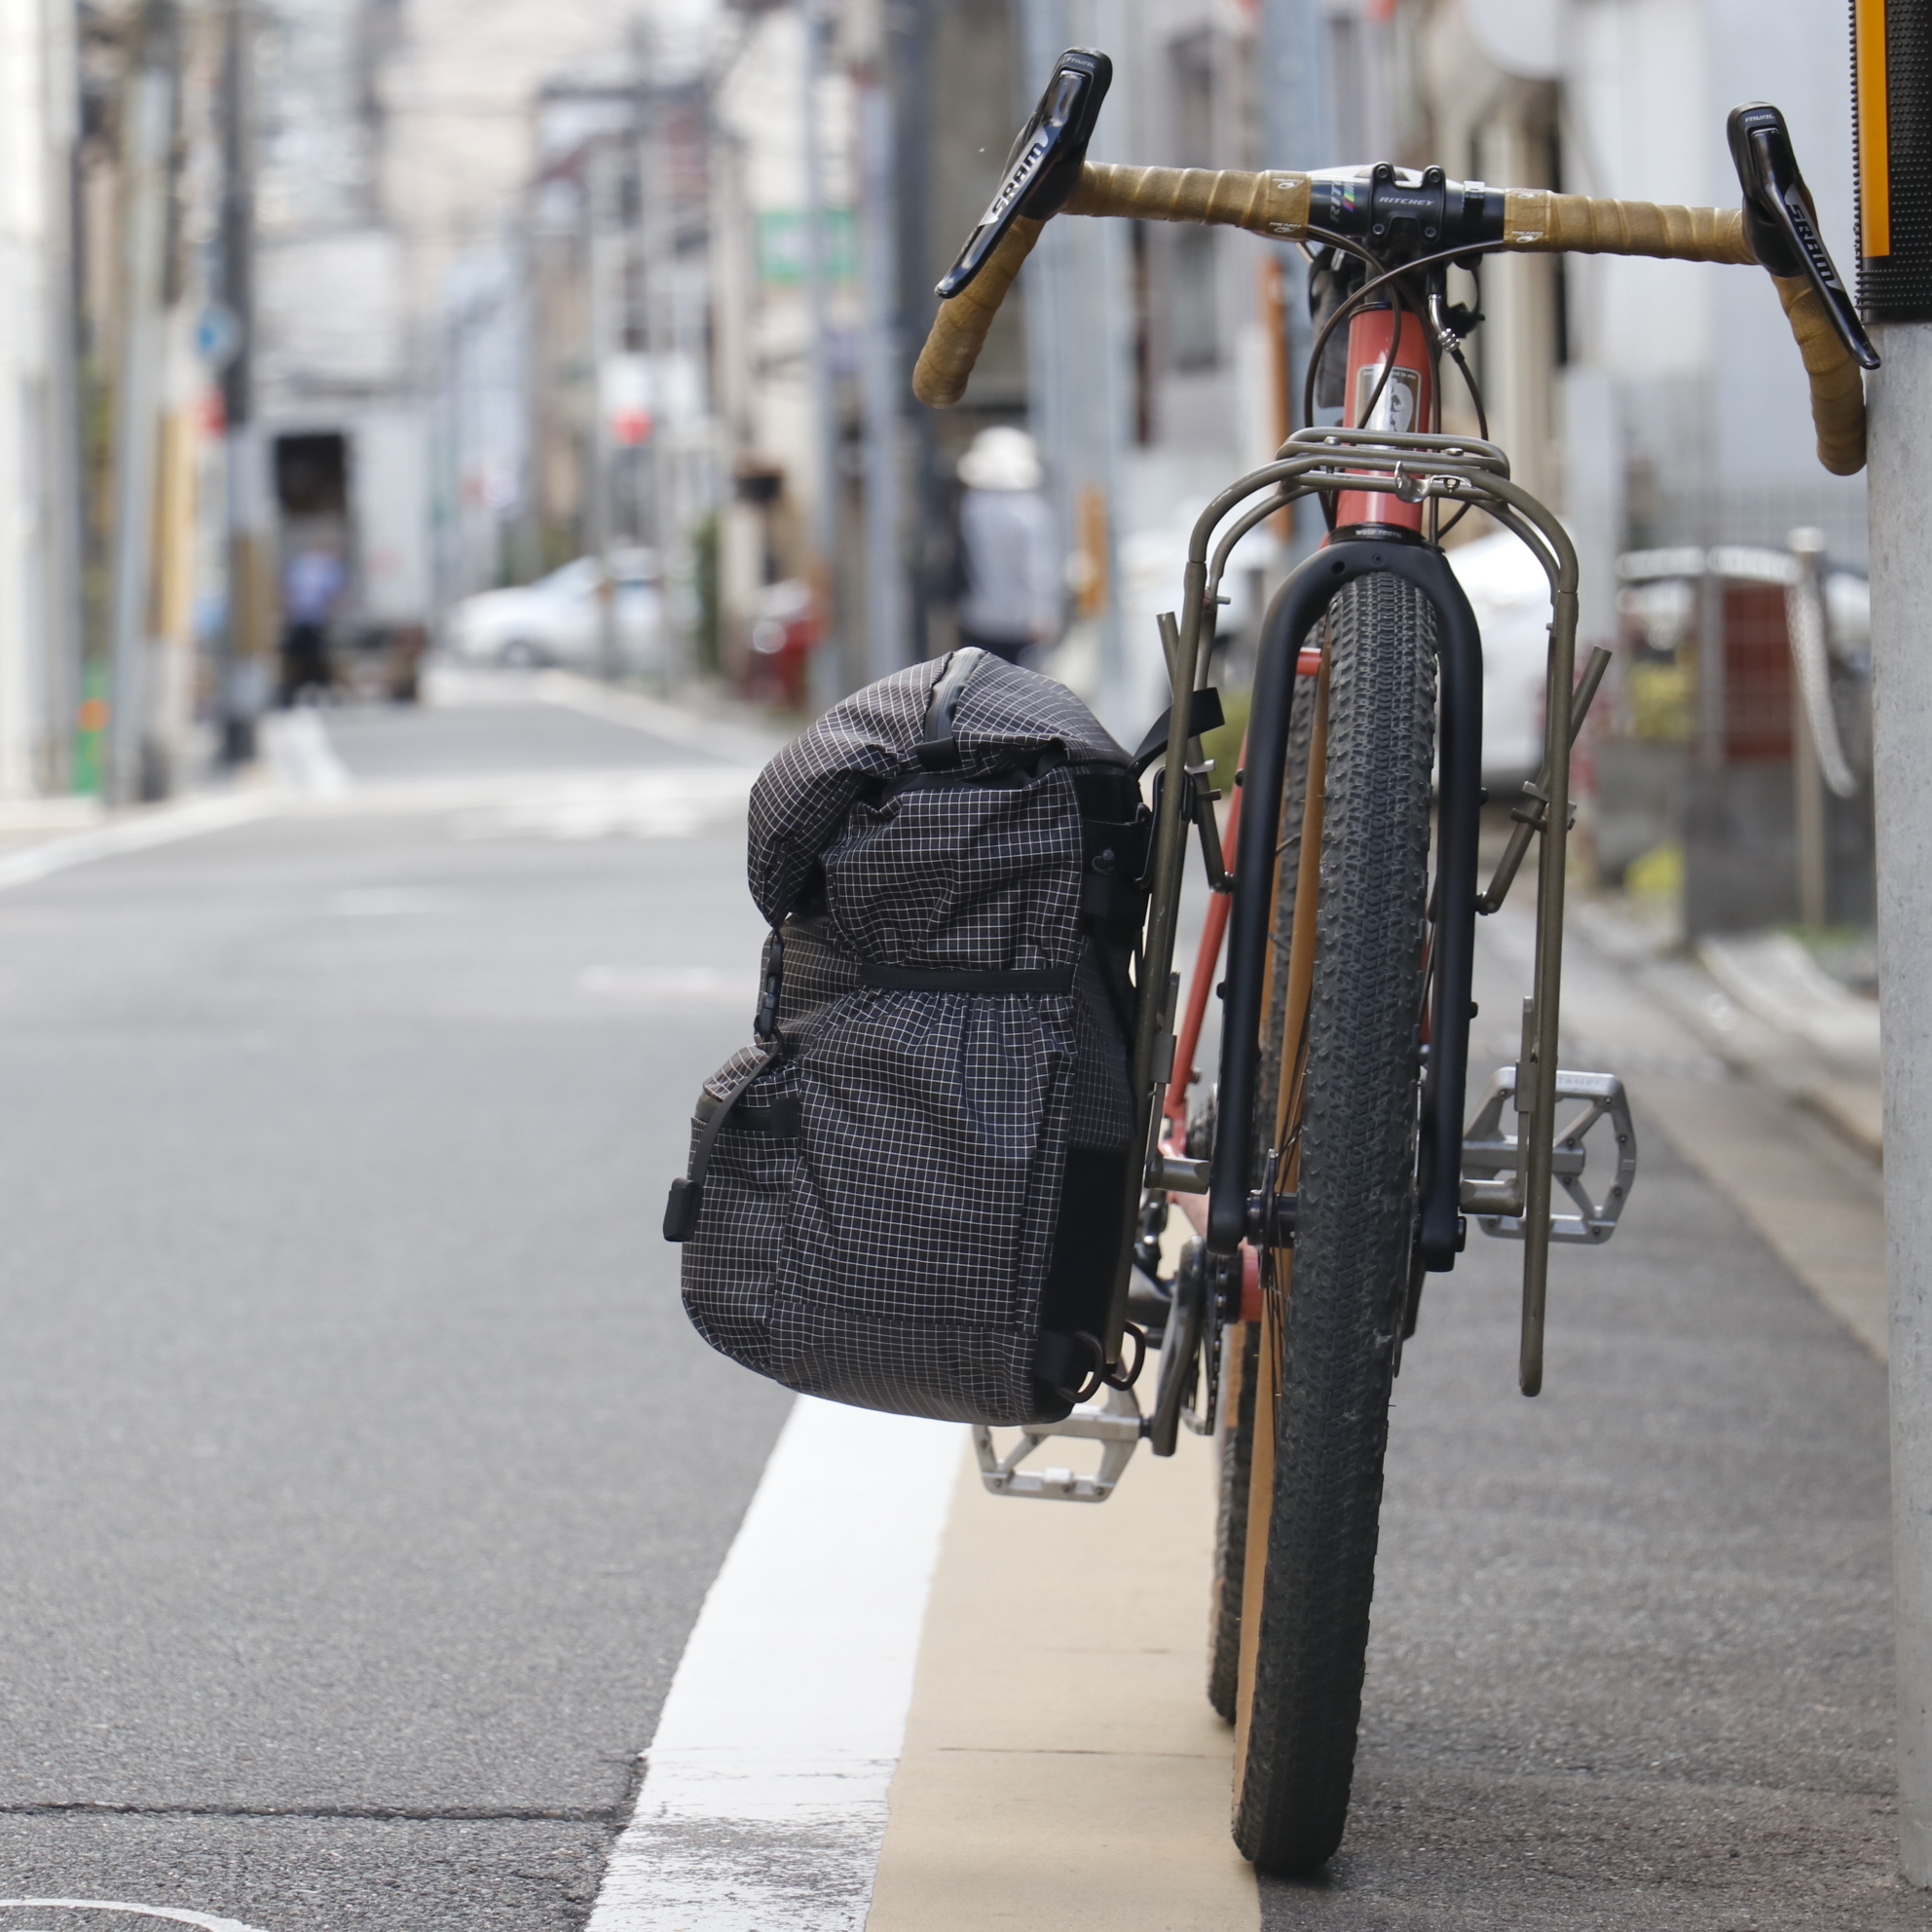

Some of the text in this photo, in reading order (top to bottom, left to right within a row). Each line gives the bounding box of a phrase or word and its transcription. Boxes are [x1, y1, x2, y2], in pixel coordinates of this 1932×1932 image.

[1745, 114, 1775, 123] RIVAL
[991, 142, 1043, 218] SRAM
[1379, 196, 1434, 206] RITCHEY
[1788, 204, 1836, 282] SRAM
[1379, 530, 1402, 539] TOOTH
